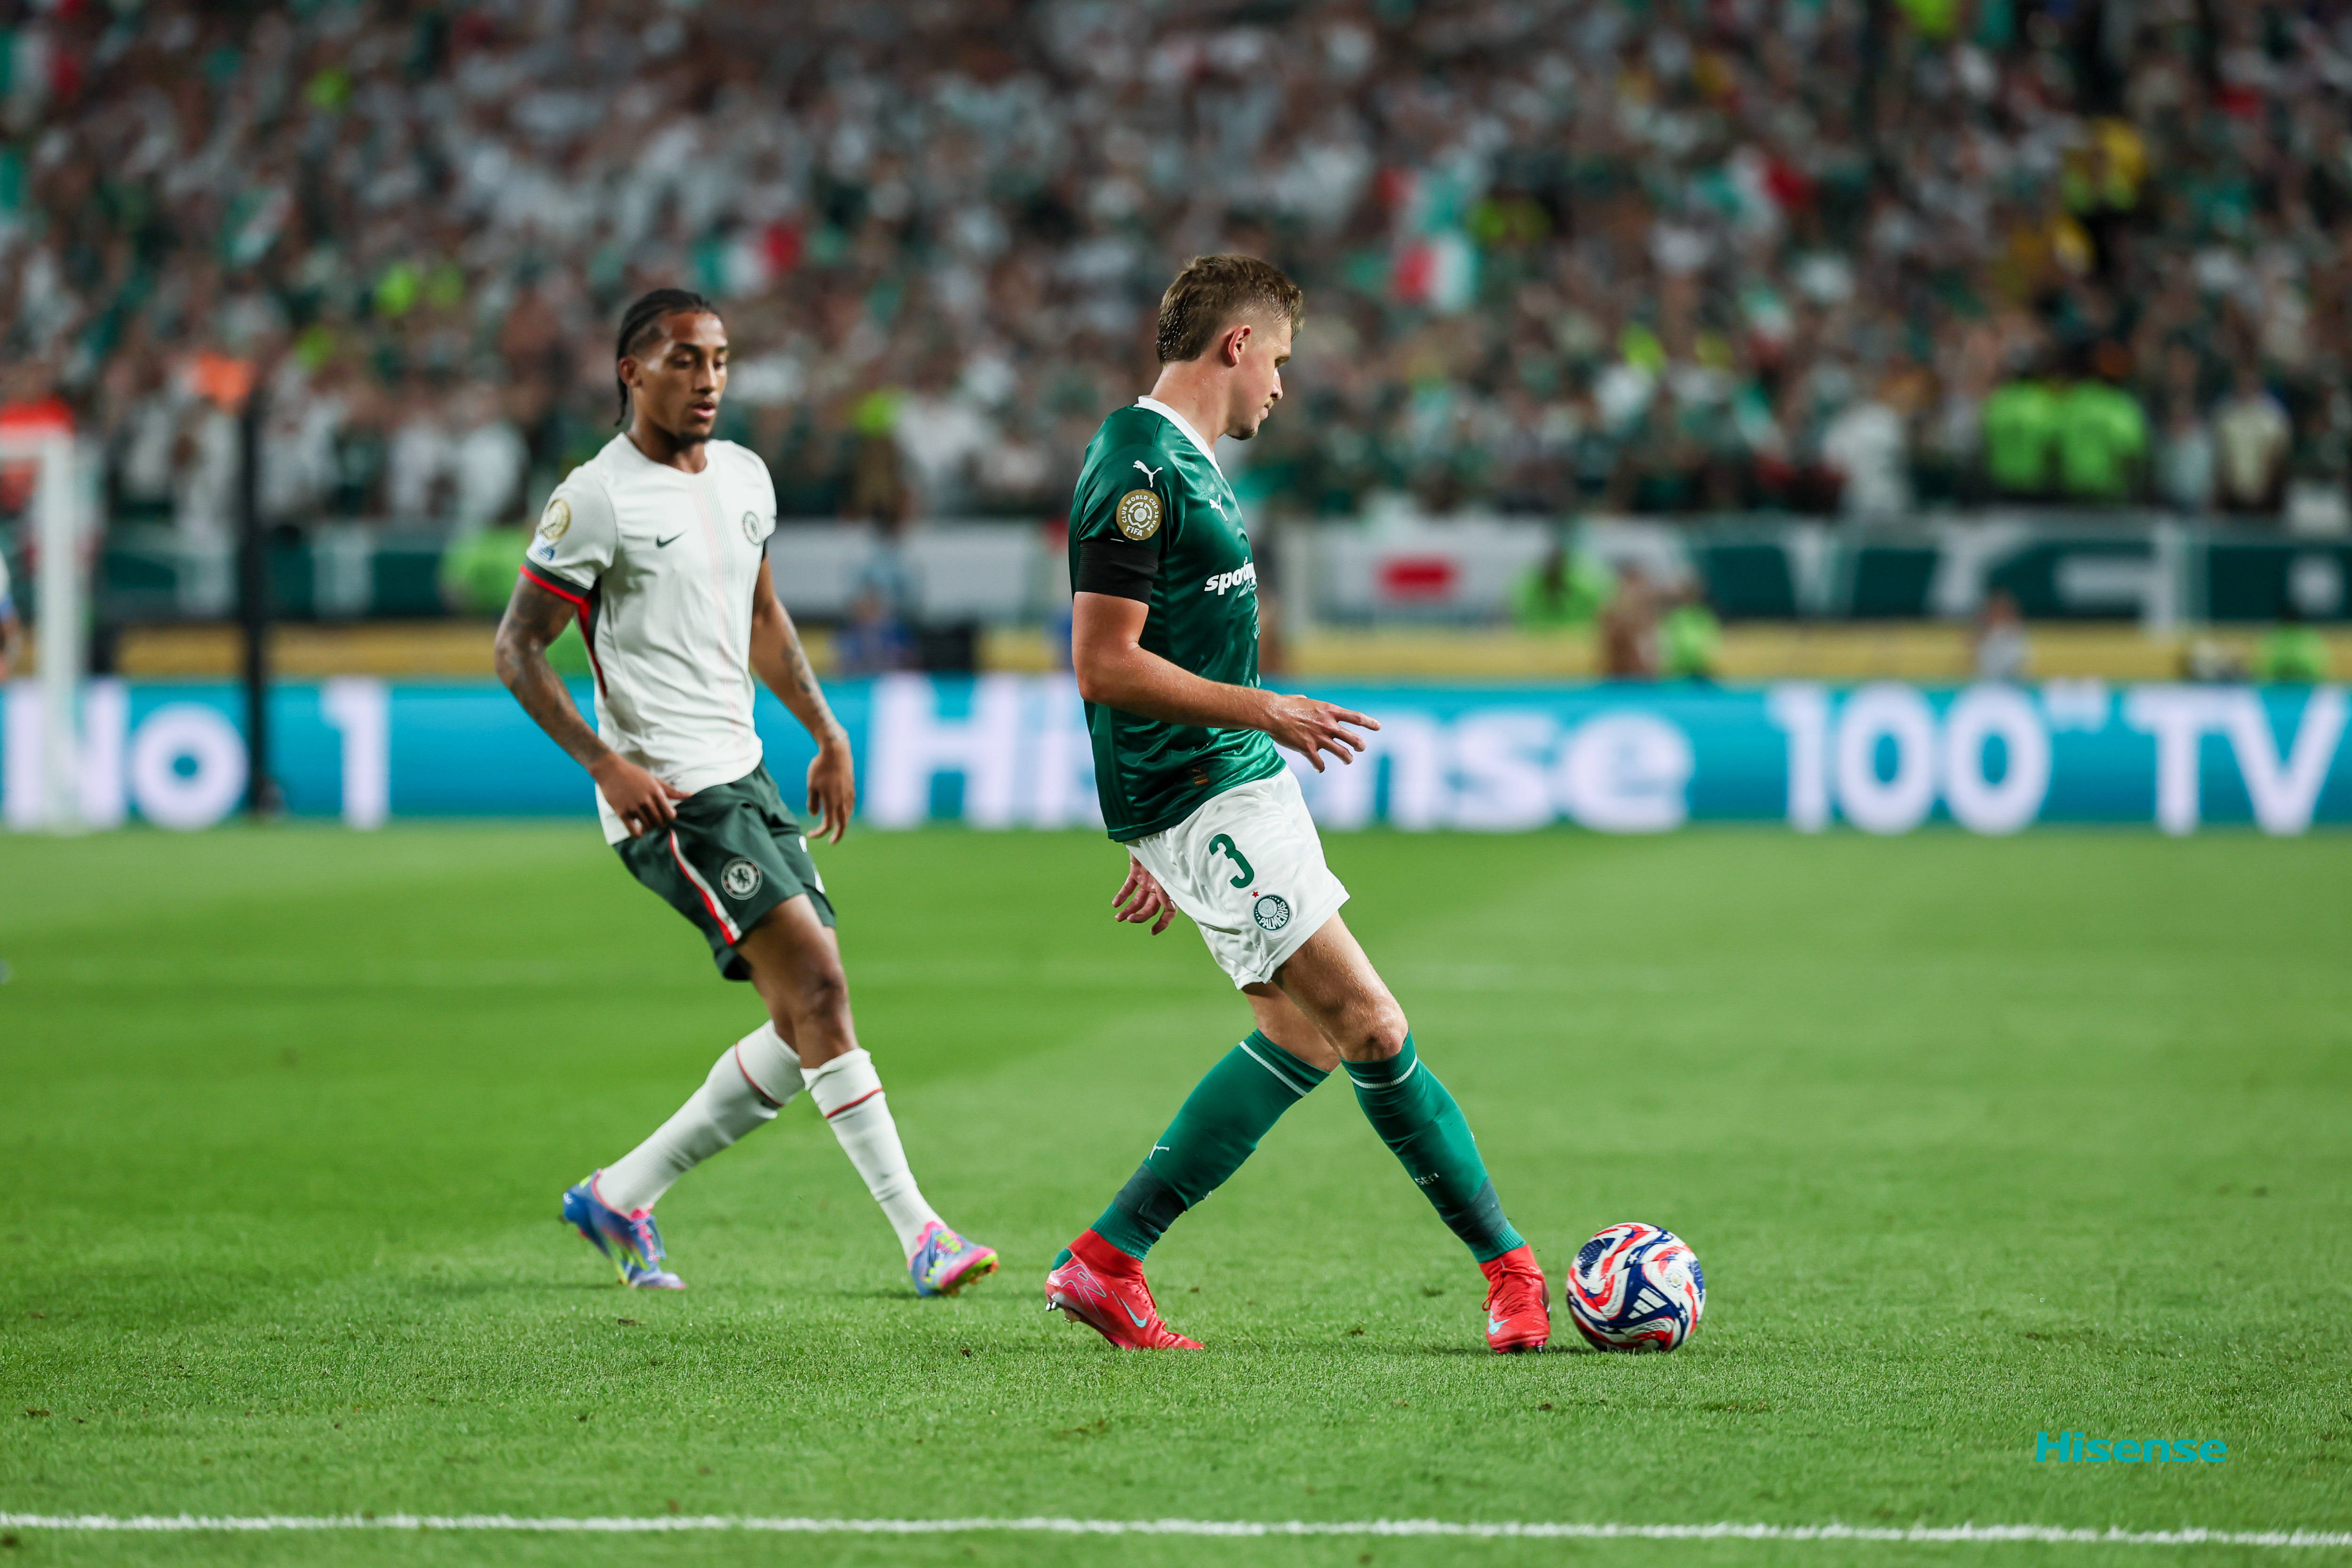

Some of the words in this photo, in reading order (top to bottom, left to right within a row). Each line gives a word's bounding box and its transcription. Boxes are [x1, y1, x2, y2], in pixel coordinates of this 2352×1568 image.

[1125, 494, 1148, 505] WORLD
[1149, 498, 1159, 509] CUP
[1126, 525, 1143, 537] FIFA
[1146, 520, 1157, 532] USA
[6, 676, 250, 833] No
[318, 676, 390, 833] 1
[865, 673, 1694, 833] Hinse
[2125, 682, 2350, 836] TV
[1208, 833, 1255, 889] 3
[1258, 901, 1288, 930] PALMEIRAS
